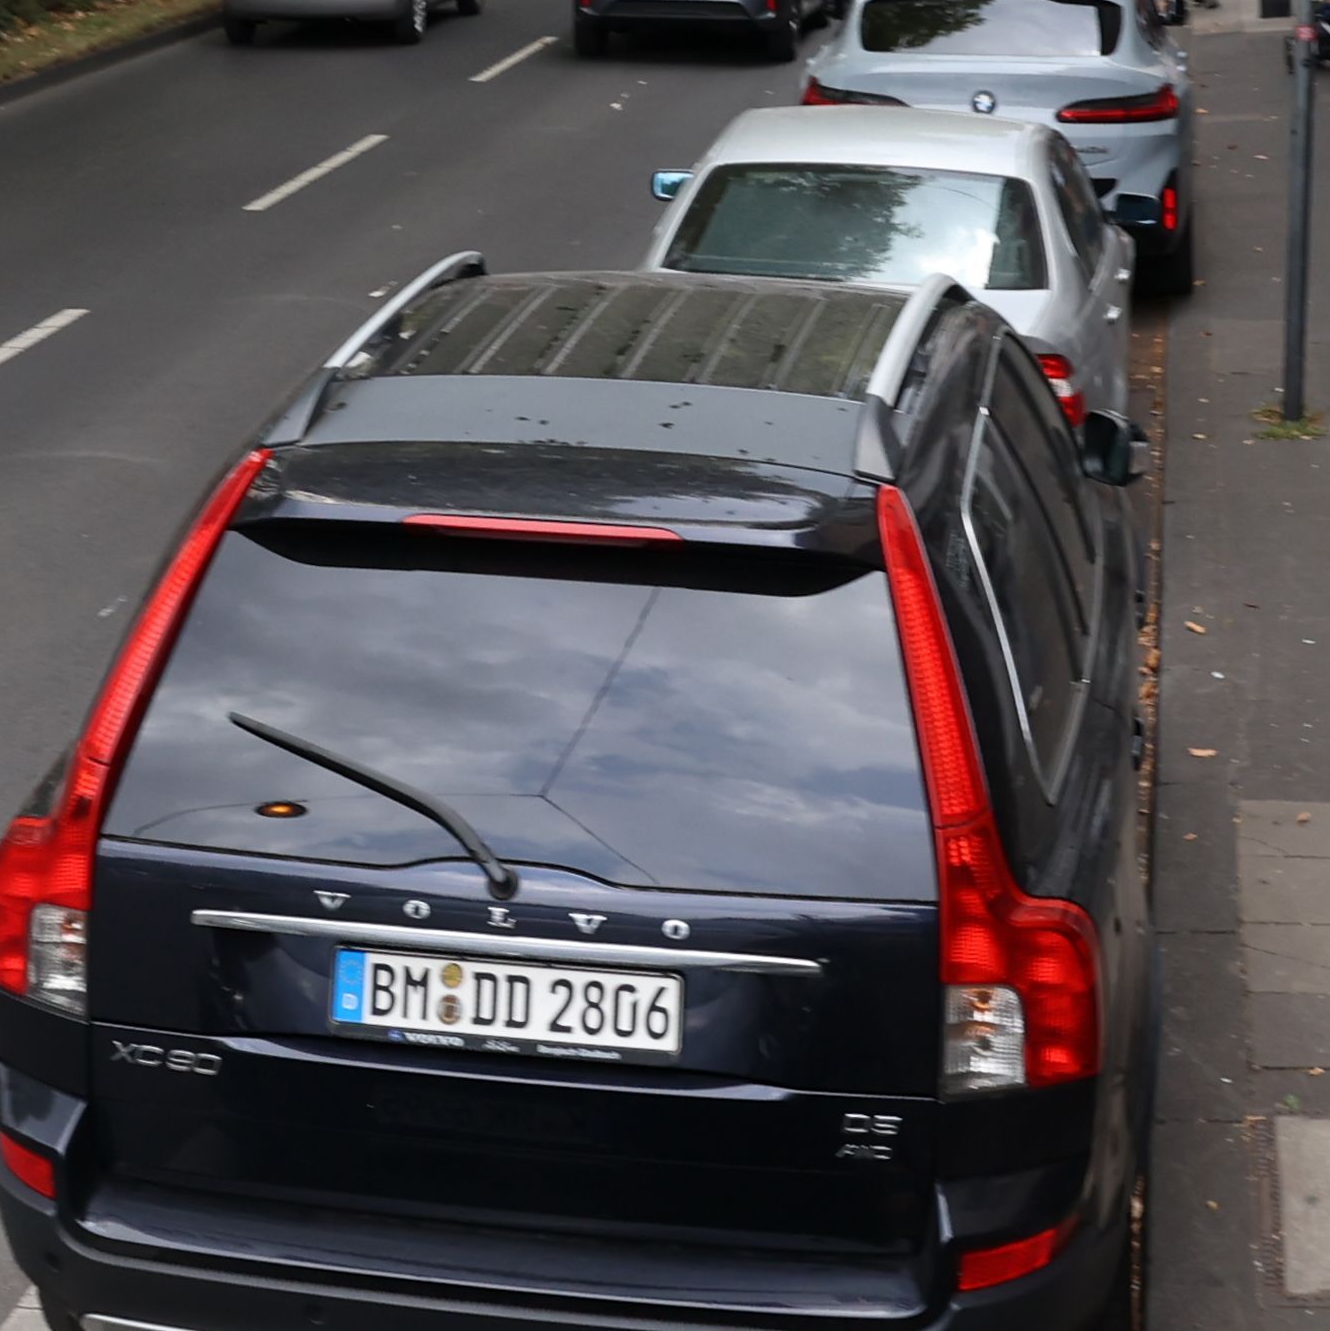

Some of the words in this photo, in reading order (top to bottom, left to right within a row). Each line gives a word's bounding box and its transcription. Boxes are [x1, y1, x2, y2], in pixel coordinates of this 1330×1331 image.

[314, 890, 690, 940] VOLVO
[372, 963, 429, 1021] BM
[474, 972, 530, 1028] DD
[549, 979, 669, 1040] 2806
[110, 1040, 222, 1075] XC90
[843, 1113, 903, 1135] D5
